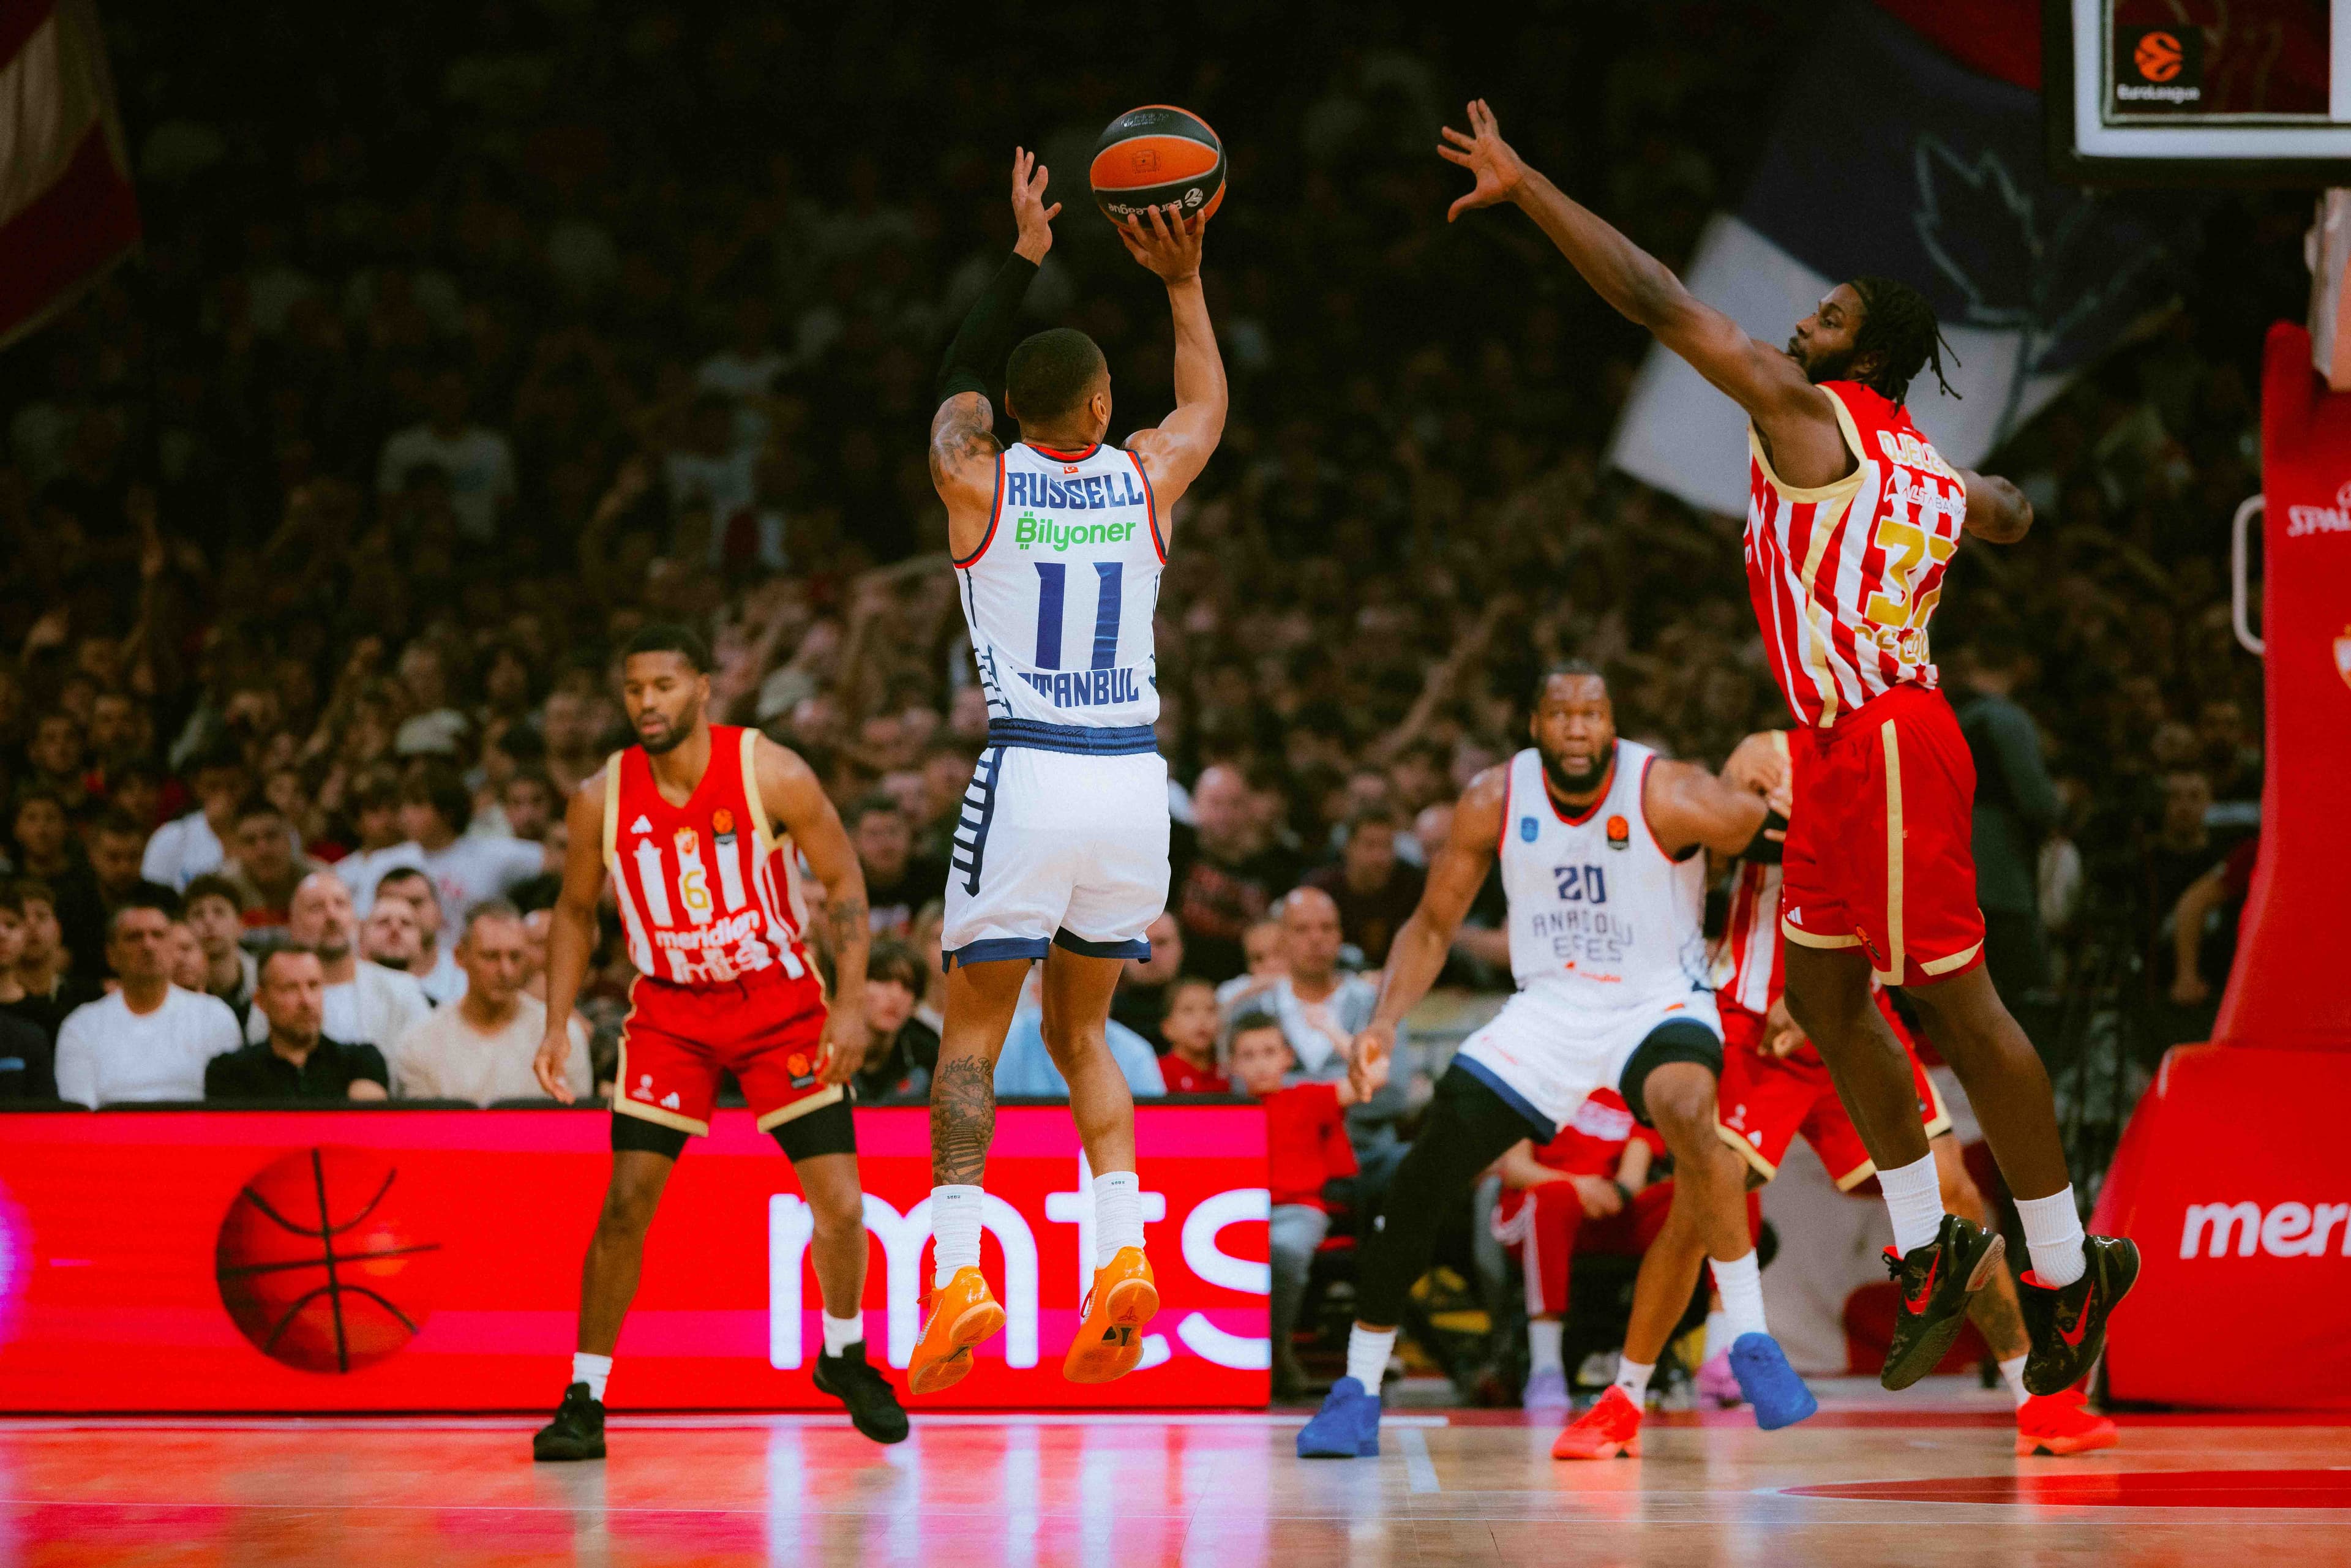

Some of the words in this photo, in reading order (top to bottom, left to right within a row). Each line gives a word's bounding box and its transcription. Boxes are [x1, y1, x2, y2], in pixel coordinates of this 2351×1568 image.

[1108, 199, 1183, 215] Eureague
[1877, 430, 1952, 479] OJELE
[1007, 471, 1144, 509] RUSSELL
[1015, 511, 1136, 552] Bilyoner
[1033, 561, 1123, 670] 11
[1010, 666, 1139, 708] TANBUL
[683, 870, 709, 909] 6
[1554, 864, 1607, 905] 20
[654, 910, 760, 950] meridian
